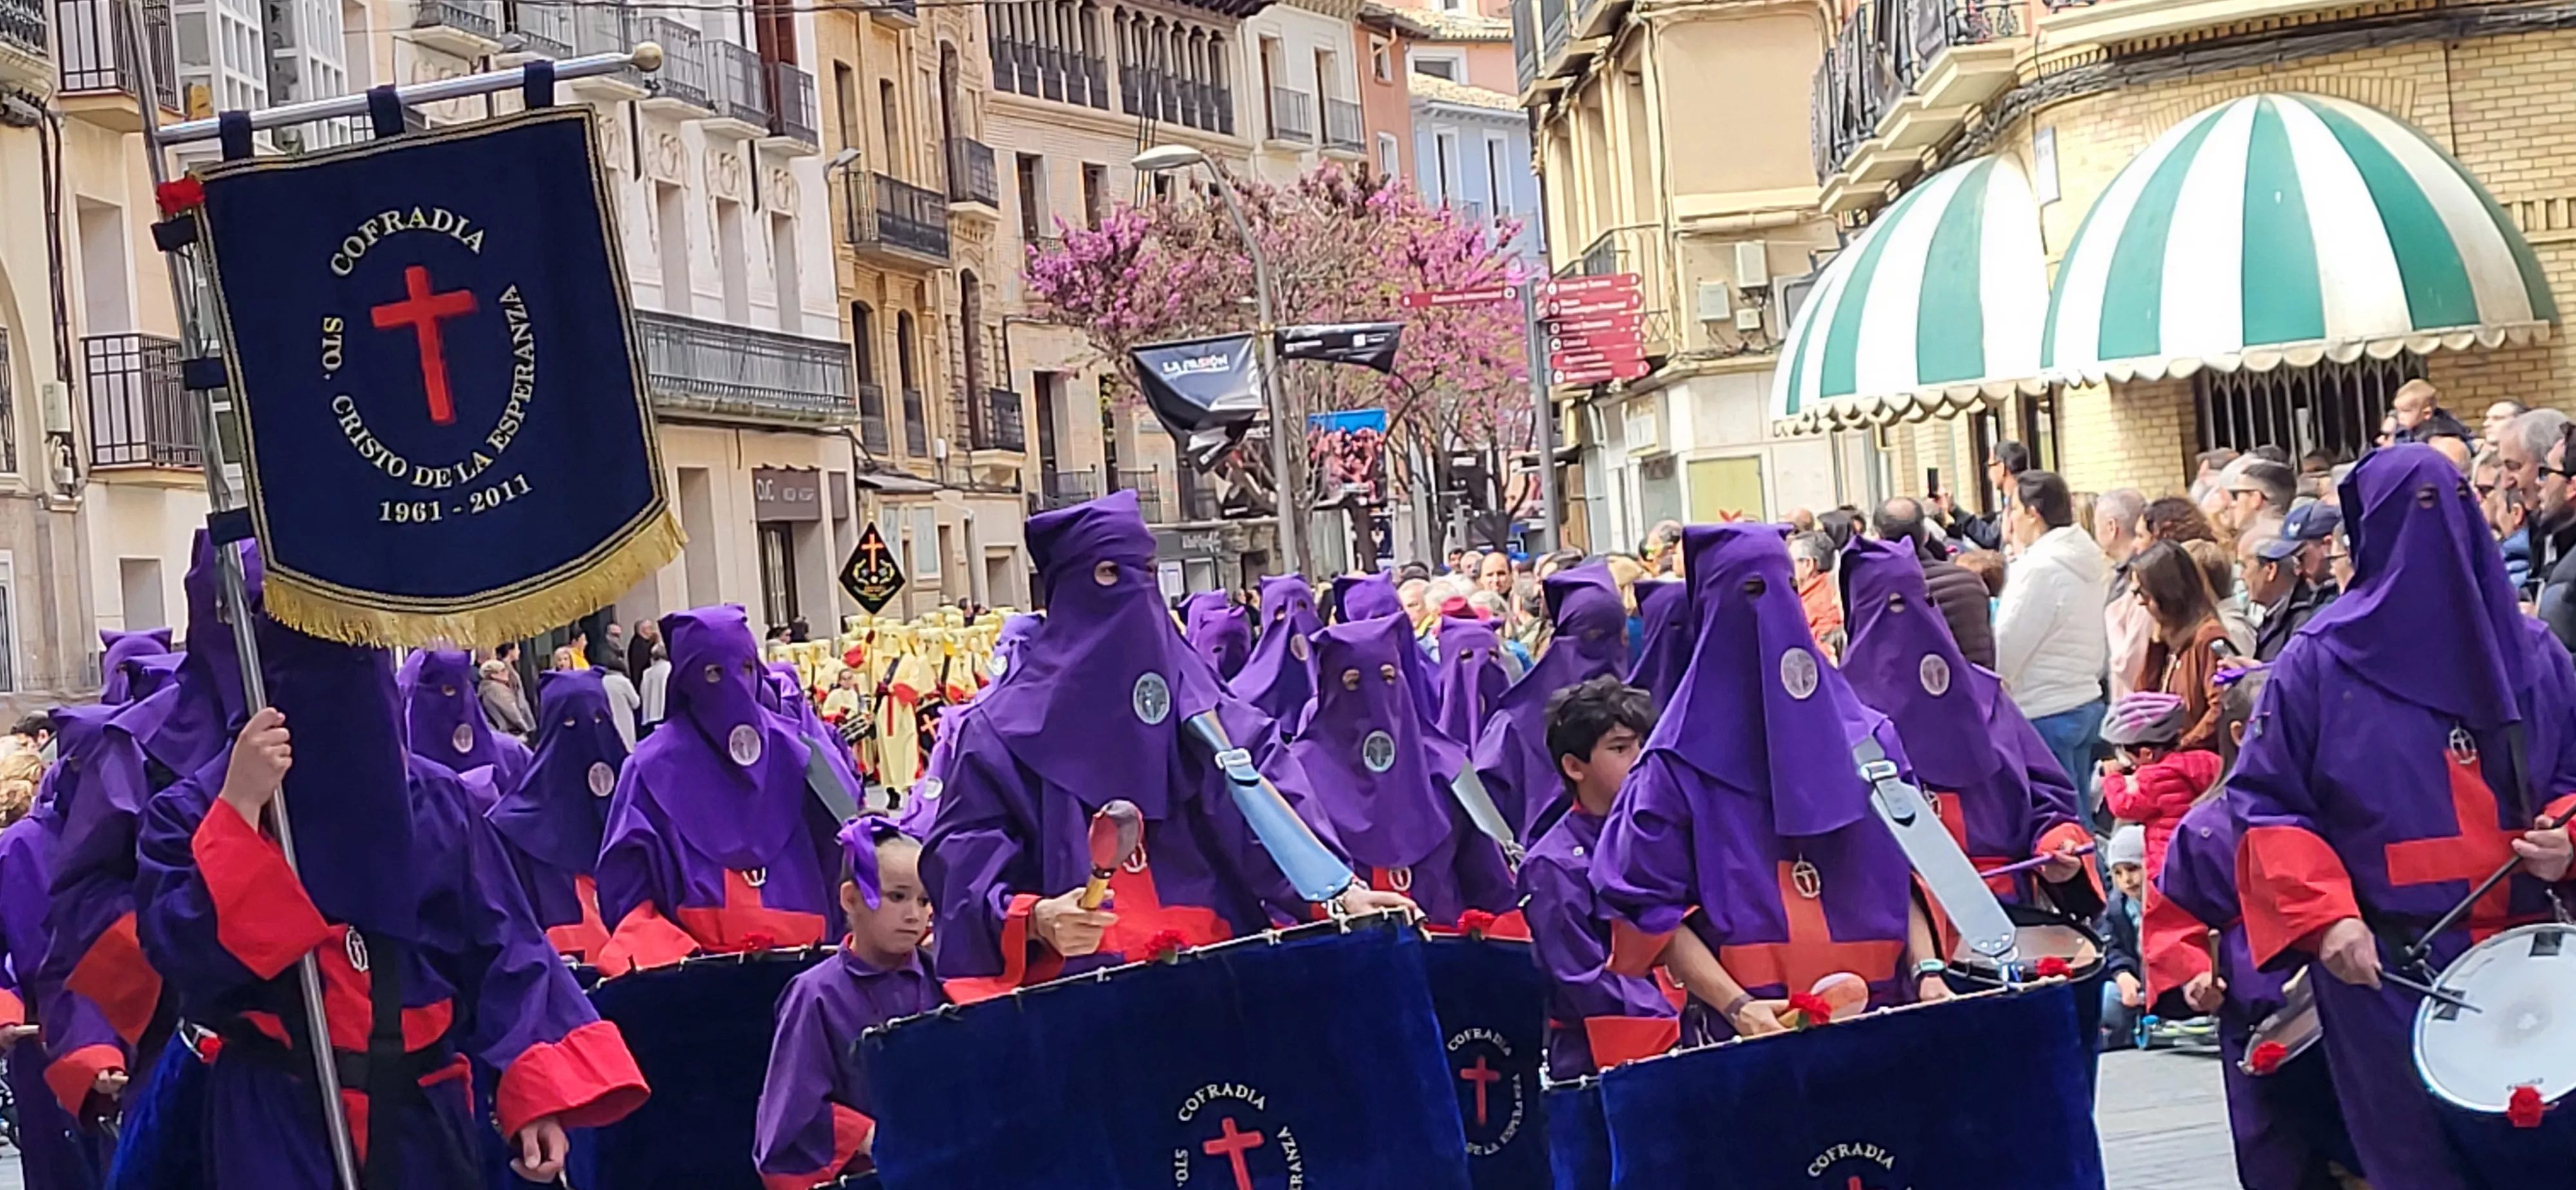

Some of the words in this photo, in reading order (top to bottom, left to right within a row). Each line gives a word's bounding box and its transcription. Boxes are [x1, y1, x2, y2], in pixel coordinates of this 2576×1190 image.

[330, 206, 484, 276] COFRADIA
[322, 317, 344, 380] STO.
[1162, 361, 1182, 373] LA
[486, 284, 535, 454] ESPERANZA
[332, 395, 408, 477] CRISTO
[411, 465, 453, 489] DE
[453, 451, 494, 484] LA
[379, 500, 444, 523] 1961
[469, 473, 533, 514] 2011
[1446, 1028, 1512, 1057] COFRADIA
[1178, 1082, 1266, 1122] COFRADIA
[1173, 1148, 1189, 1187] STO.
[1807, 1142, 1895, 1178] COFRADIA
